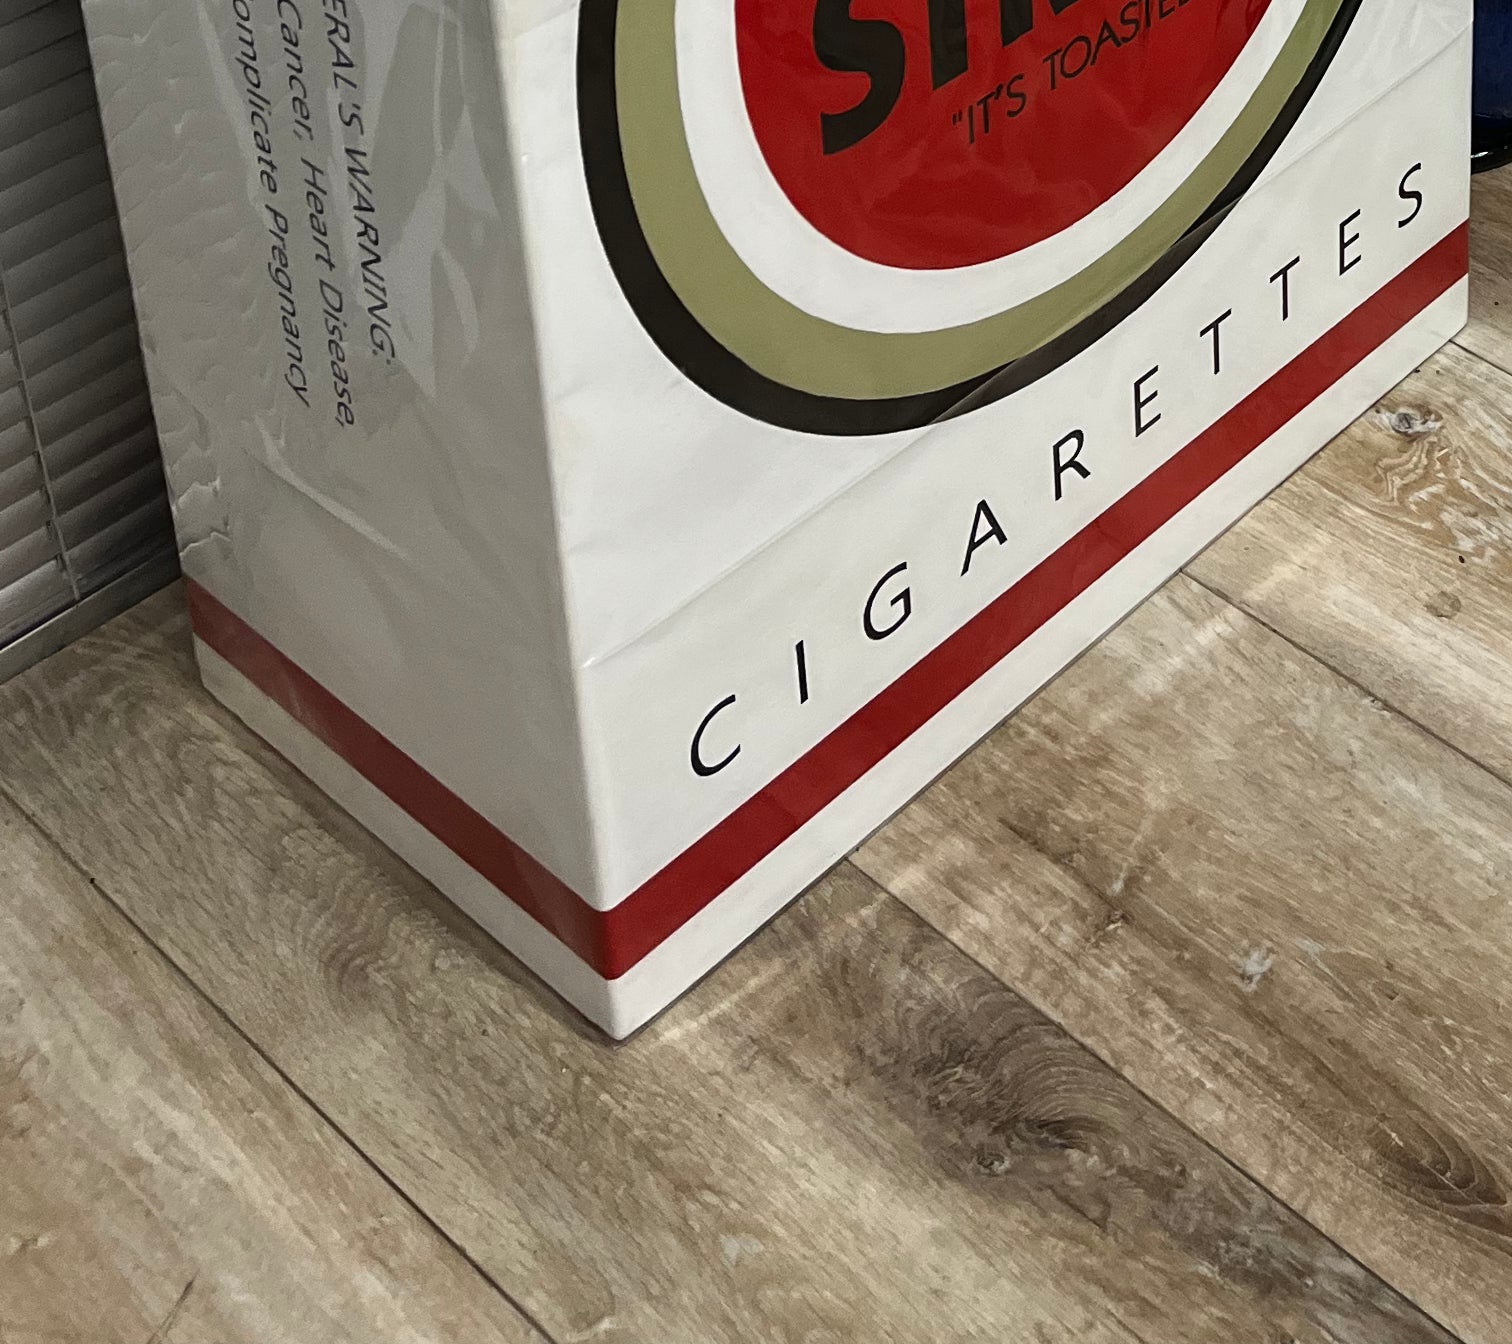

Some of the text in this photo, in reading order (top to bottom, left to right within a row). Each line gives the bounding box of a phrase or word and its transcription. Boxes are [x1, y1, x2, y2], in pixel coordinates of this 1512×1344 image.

[952, 74, 1027, 144] "IT'S
[301, 154, 336, 271] Heart
[343, 145, 395, 365] WARNING:
[263, 203, 310, 408] Pregnancy
[317, 277, 355, 429] Disease,
[688, 159, 1428, 778] CIGARETTES
